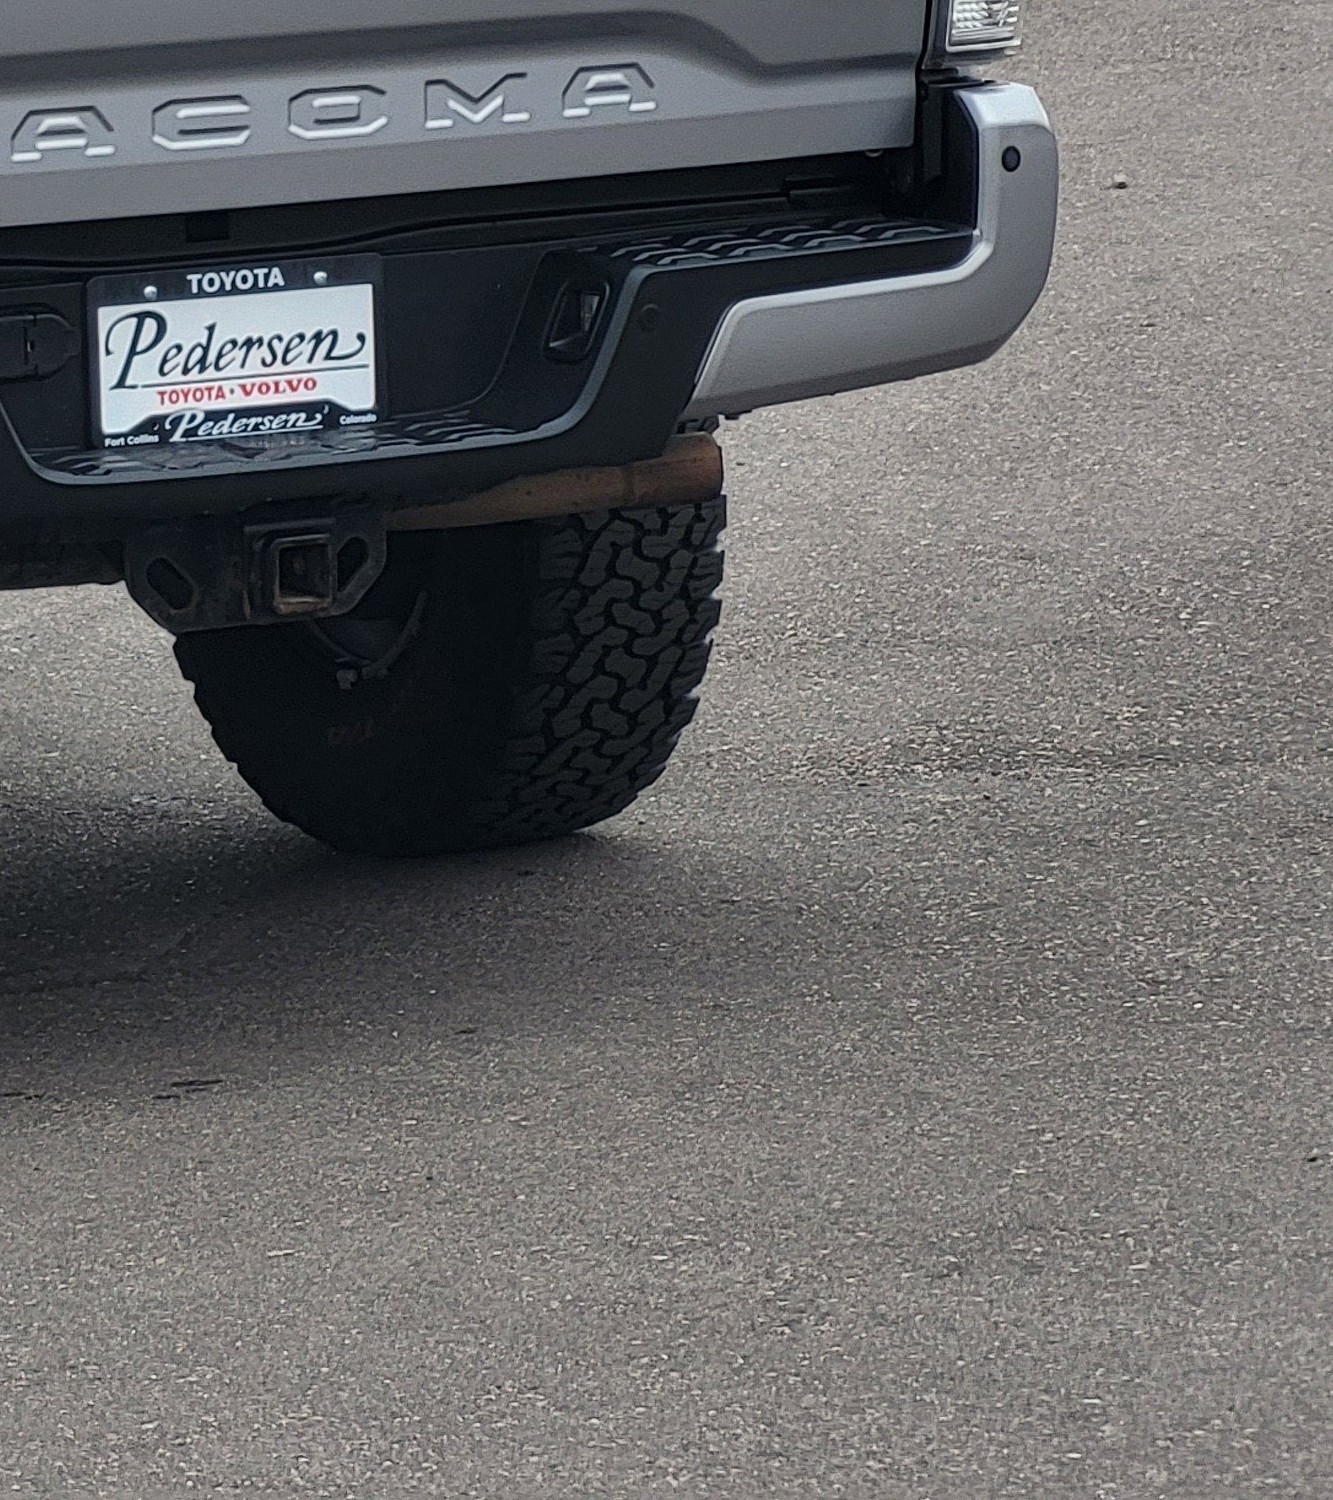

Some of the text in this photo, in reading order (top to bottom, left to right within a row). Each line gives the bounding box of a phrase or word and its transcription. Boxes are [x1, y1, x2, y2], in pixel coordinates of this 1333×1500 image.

[187, 266, 285, 295] TOYOTA
[105, 310, 366, 390] Pedersen
[157, 377, 318, 406] TOYOTA VOLVO
[164, 409, 323, 442] Pedersen
[339, 413, 377, 426] Colorado
[104, 433, 160, 448] Fort Collins
